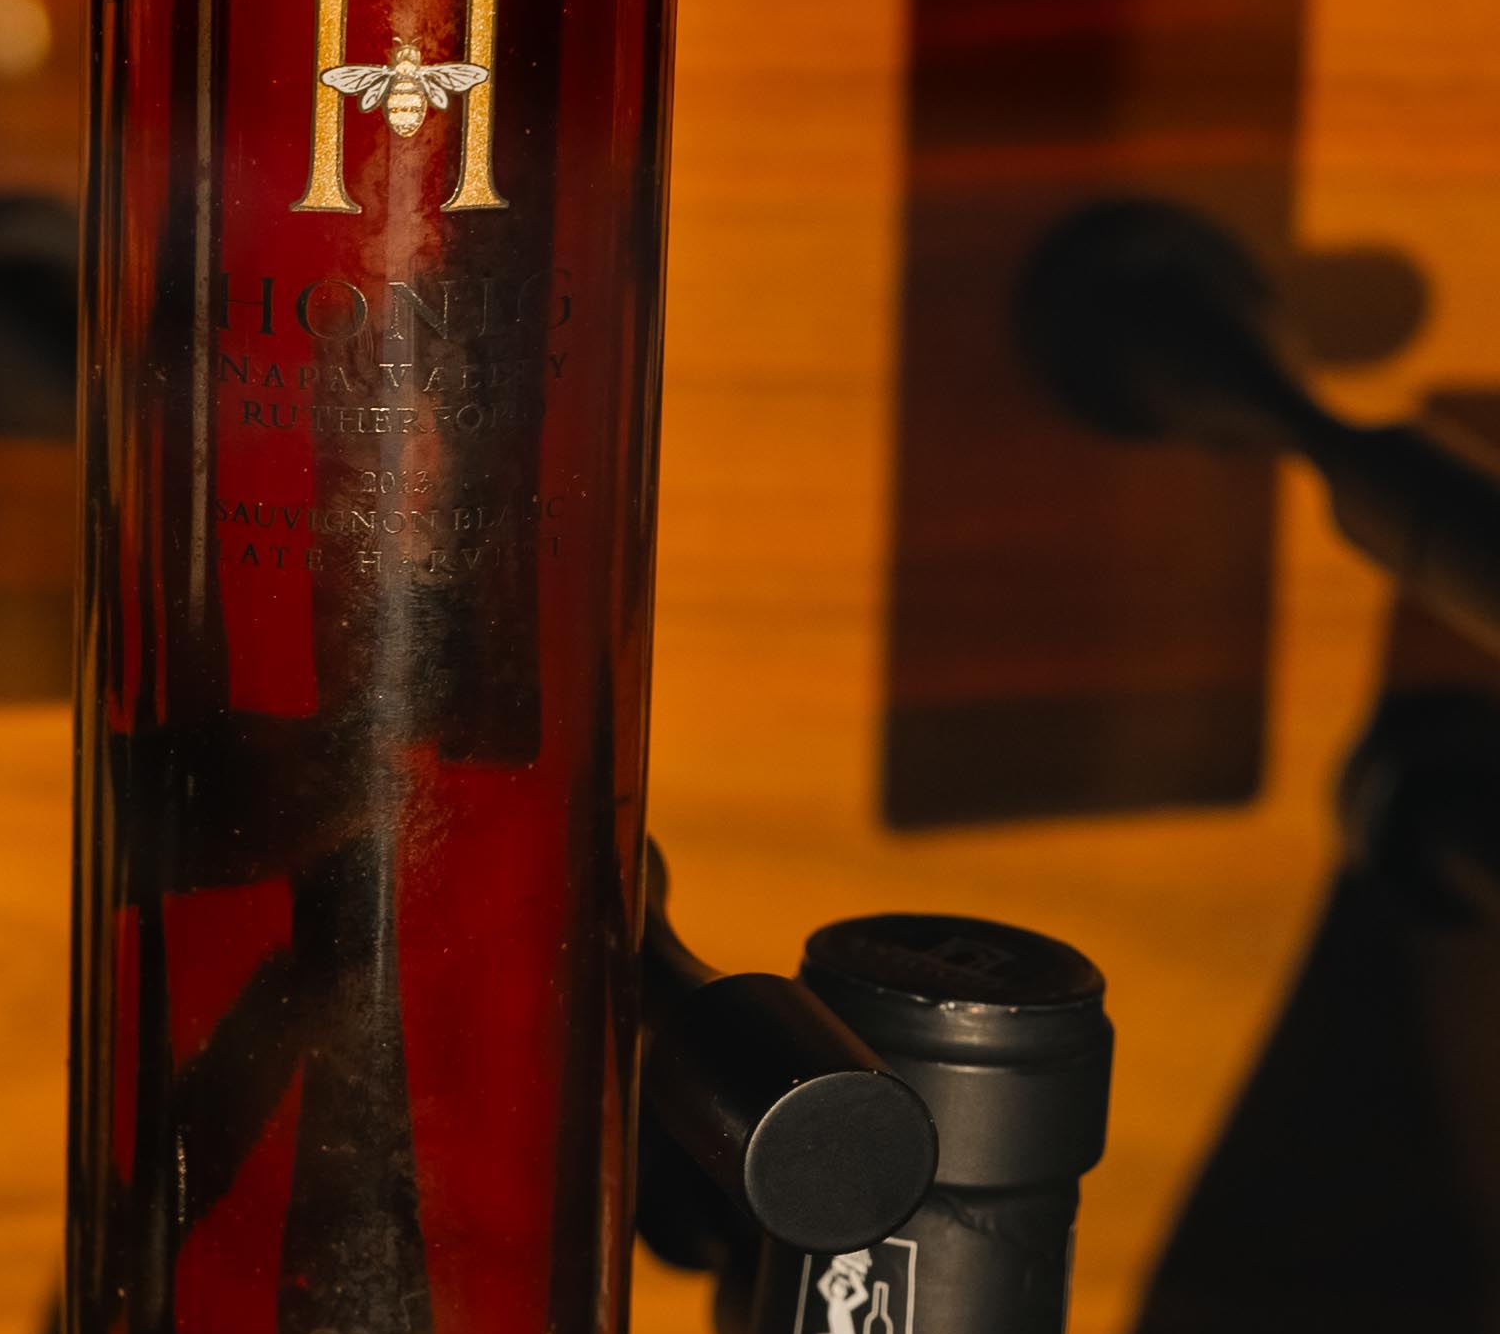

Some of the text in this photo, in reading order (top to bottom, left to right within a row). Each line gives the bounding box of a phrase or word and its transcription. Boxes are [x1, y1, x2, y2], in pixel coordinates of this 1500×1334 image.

[217, 267, 573, 341] HONIG
[218, 351, 569, 392] NAPA VALLY
